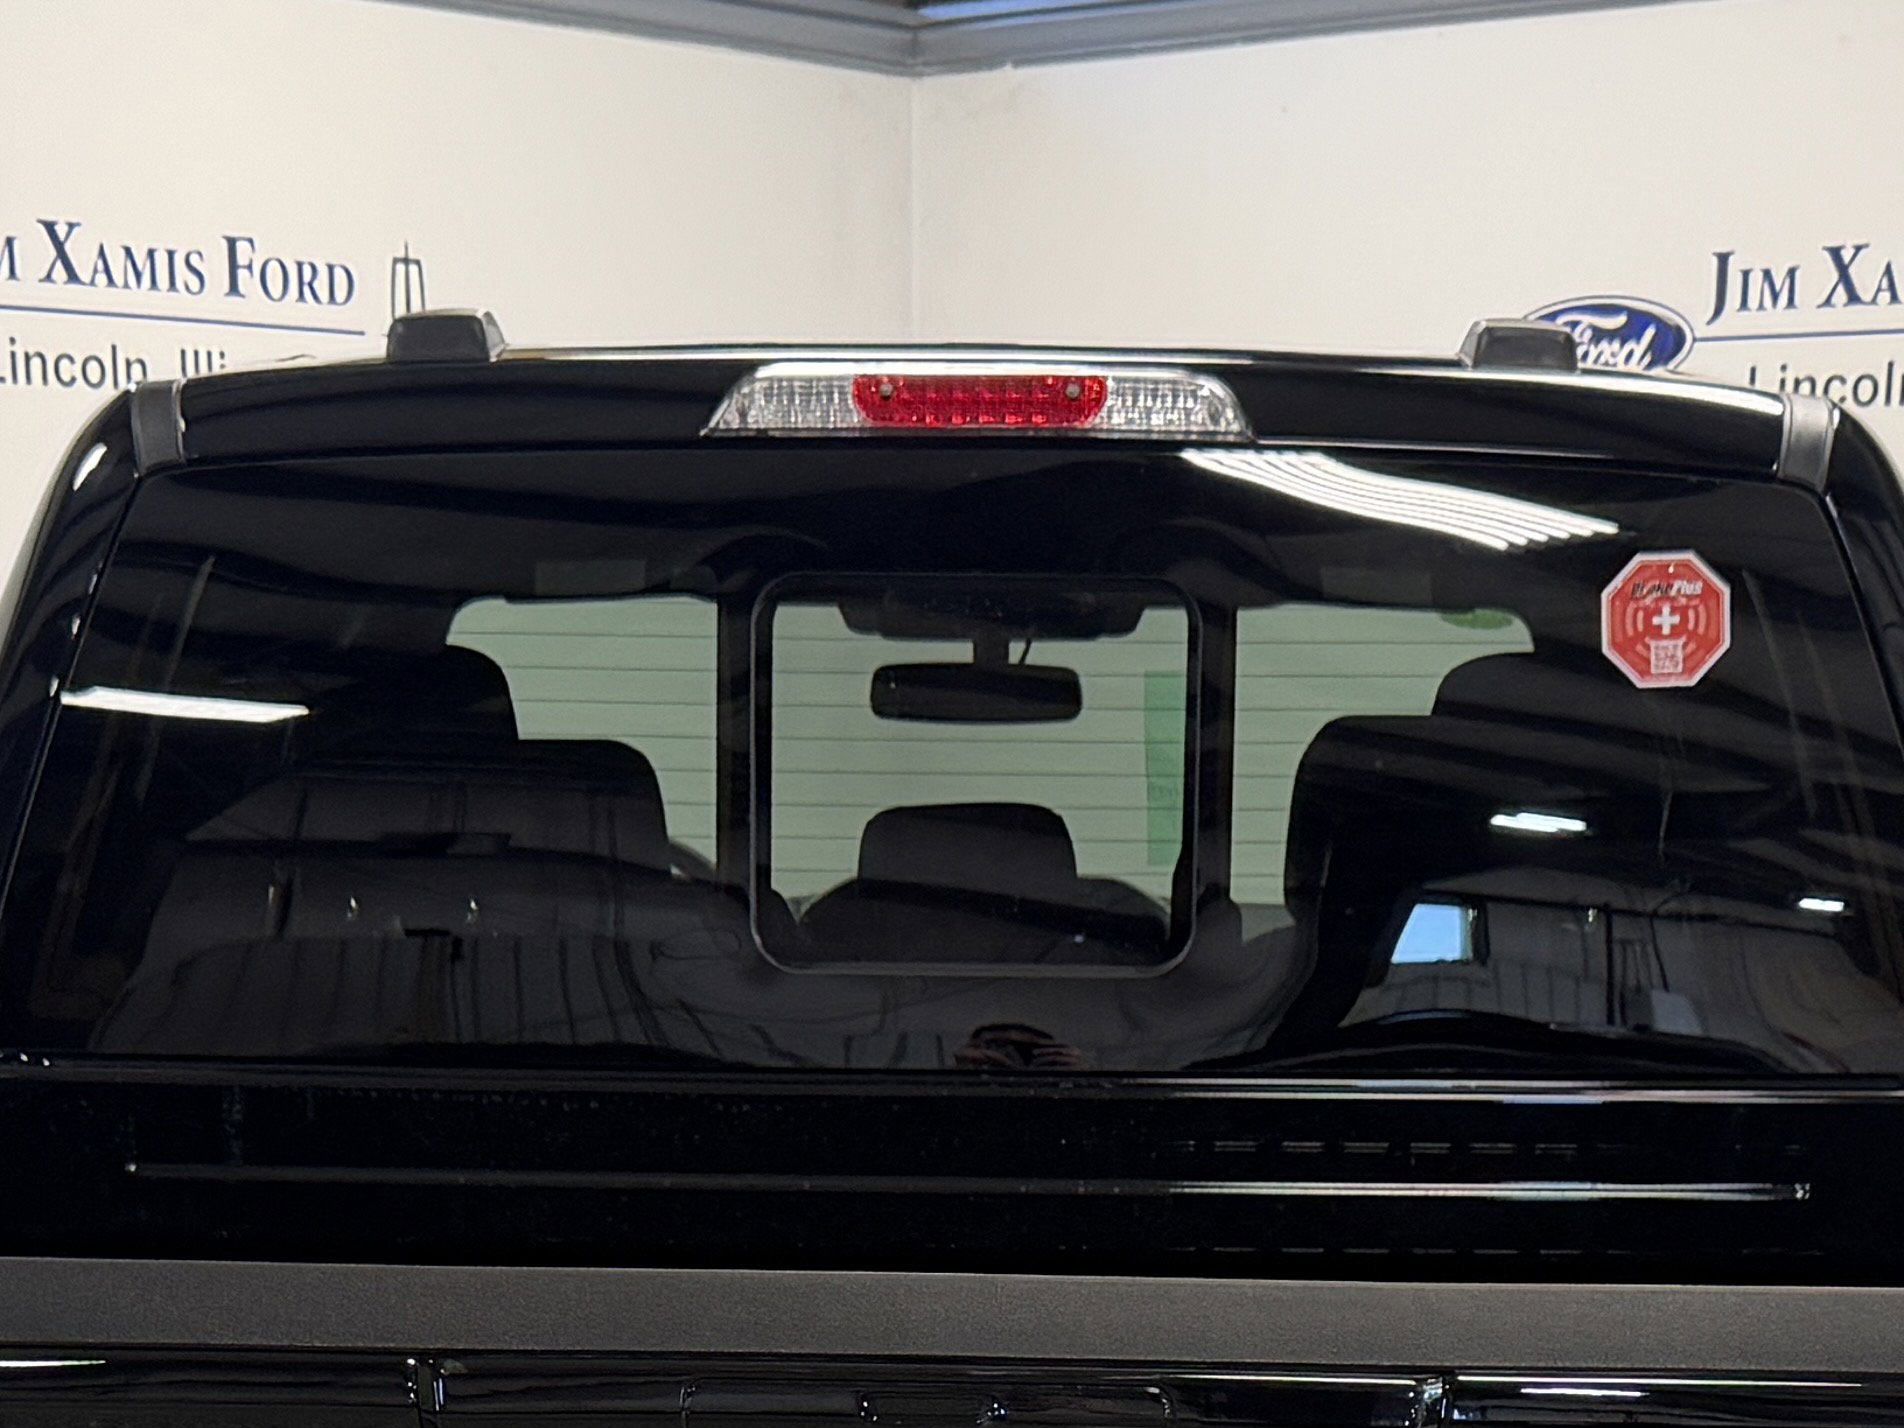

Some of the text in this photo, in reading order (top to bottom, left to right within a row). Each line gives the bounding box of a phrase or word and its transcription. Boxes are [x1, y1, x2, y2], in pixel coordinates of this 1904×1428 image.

[35, 219, 207, 295] XAMIS
[222, 235, 356, 307] FORD
[1705, 249, 1800, 326] JIM
